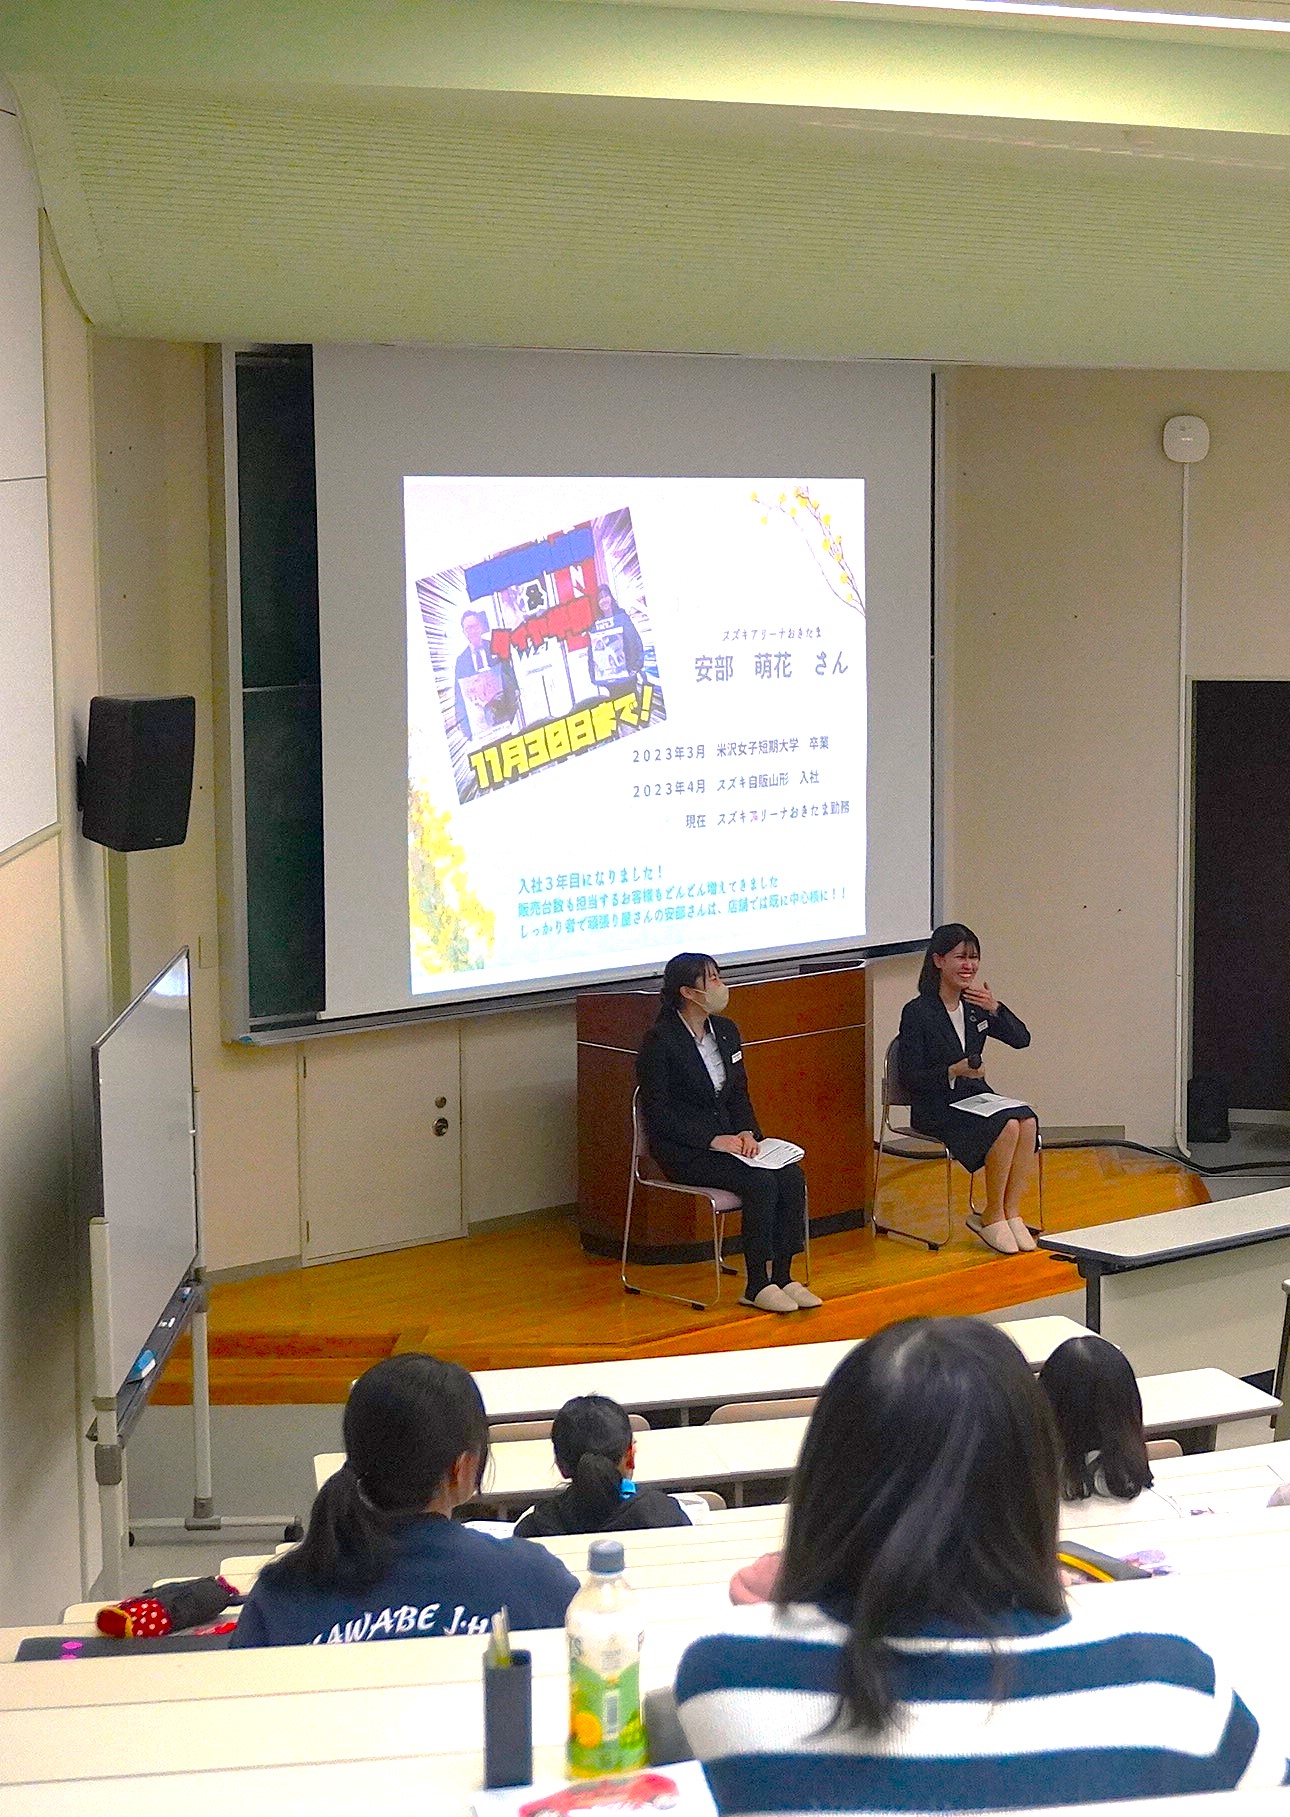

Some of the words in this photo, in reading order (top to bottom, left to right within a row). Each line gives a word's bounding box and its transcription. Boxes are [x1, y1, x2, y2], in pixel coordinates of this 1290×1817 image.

[722, 626, 822, 642] スズキアリーナおきたま
[694, 654, 734, 683] 安部
[754, 651, 792, 680] 萌花
[815, 650, 849, 676] さん
[632, 744, 706, 763] 2023年3月
[716, 737, 800, 757] 米沢女子短期大学
[809, 735, 830, 751] 卒業
[632, 779, 706, 798] 2023年4月
[716, 771, 790, 792] スズキ自販山形
[799, 769, 820, 785] 入社
[685, 813, 707, 829] 現在
